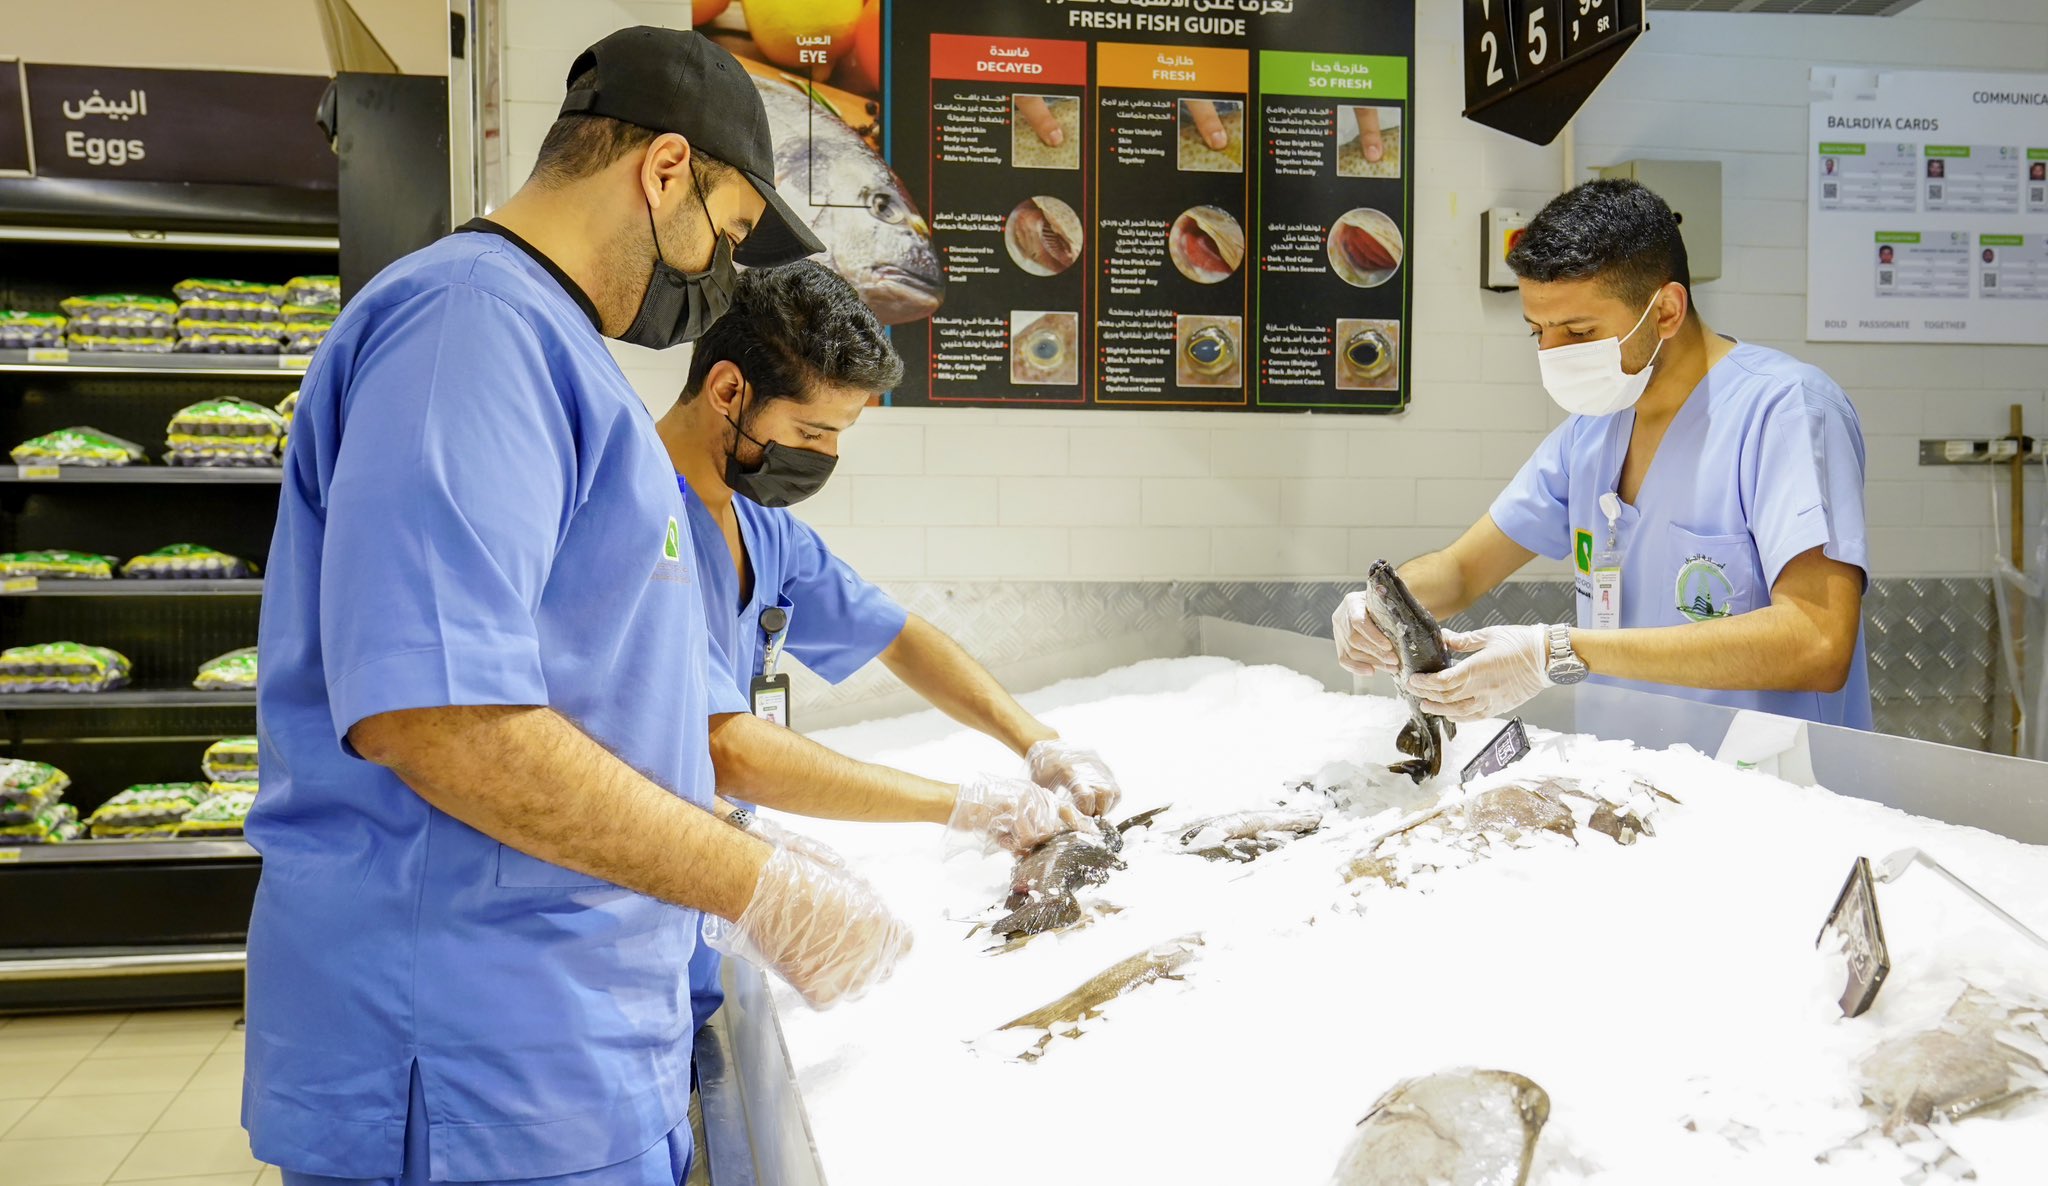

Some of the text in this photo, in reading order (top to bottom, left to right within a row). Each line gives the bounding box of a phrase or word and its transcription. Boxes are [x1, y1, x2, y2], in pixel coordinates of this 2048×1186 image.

[1069, 10, 1246, 35] FRESH FISH GUIDE
[1597, 16, 1610, 32] SR
[796, 34, 831, 46] العين
[800, 50, 827, 63] EYE
[990, 46, 1029, 57] فاسدة
[1157, 53, 1194, 66] طازجة
[977, 61, 1042, 74] DECAYED
[1334, 63, 1369, 75] طازجة
[1153, 70, 1196, 81] FRESH
[1309, 77, 1372, 89] SO FRESH
[1972, 91, 2048, 106] COMMUNICA
[63, 89, 147, 122] البيض
[1896, 118, 1939, 131] CARDS
[66, 130, 145, 166] Eggs
[1825, 320, 1966, 330] BOLD PASSIONATE TOGETHER
